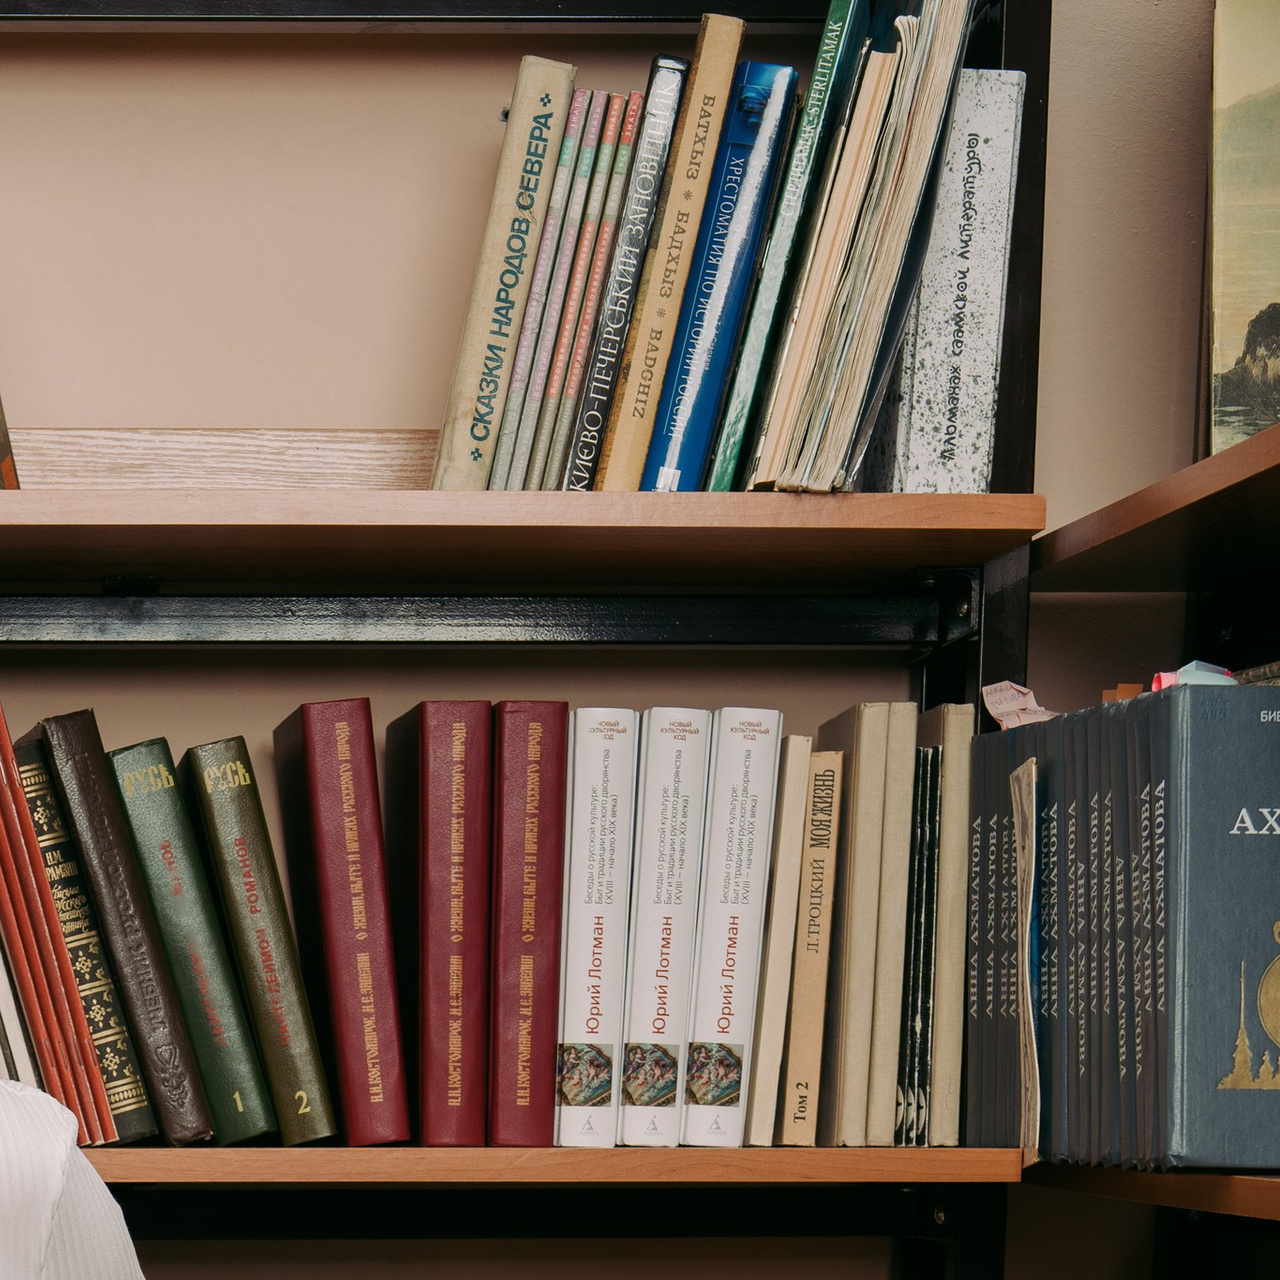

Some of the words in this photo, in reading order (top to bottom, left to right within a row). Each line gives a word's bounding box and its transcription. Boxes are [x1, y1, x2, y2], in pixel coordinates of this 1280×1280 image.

[808, 21, 844, 116] STERLITAMAK
[625, 102, 639, 138] ЗНАТЬ
[687, 94, 717, 181] БАТХЫЗ
[470, 344, 507, 442] СКАЗКИ
[490, 217, 531, 338] НАРОДОВ
[515, 112, 554, 211] СЕВЕРА
[660, 211, 691, 299] БАДХЫЗ
[702, 273, 718, 293] ПО
[684, 298, 710, 371] ИСТОРИИ
[632, 328, 663, 419] BADGHIZ
[668, 376, 693, 438] РОССИИ
[602, 750, 611, 800] дворянства
[812, 769, 836, 818] ЖИЗНЬ
[591, 785, 599, 825] культуре:
[600, 800, 609, 842] русского
[589, 828, 597, 862] русской
[810, 819, 832, 850] МОЯ
[1155, 780, 1166, 929] АХМАТОВА
[235, 836, 261, 915] РОМАНОВ
[598, 842, 606, 883] традиции
[971, 816, 982, 946] АХМАТОВА
[585, 873, 597, 905] Беседы
[595, 893, 603, 905] Быт
[589, 916, 604, 980] Лотман
[656, 917, 673, 980] Лотман
[722, 916, 740, 980] Лотман
[970, 951, 979, 1019] АННА
[1156, 935, 1165, 1013] АННА
[586, 986, 603, 1035] Юрий
[652, 986, 670, 1035] Юрий
[717, 986, 735, 1035] Юрий
[233, 1091, 245, 1113] 1
[295, 1091, 312, 1115] 2
[794, 1095, 808, 1124] Том
[796, 1082, 809, 1091] 2
